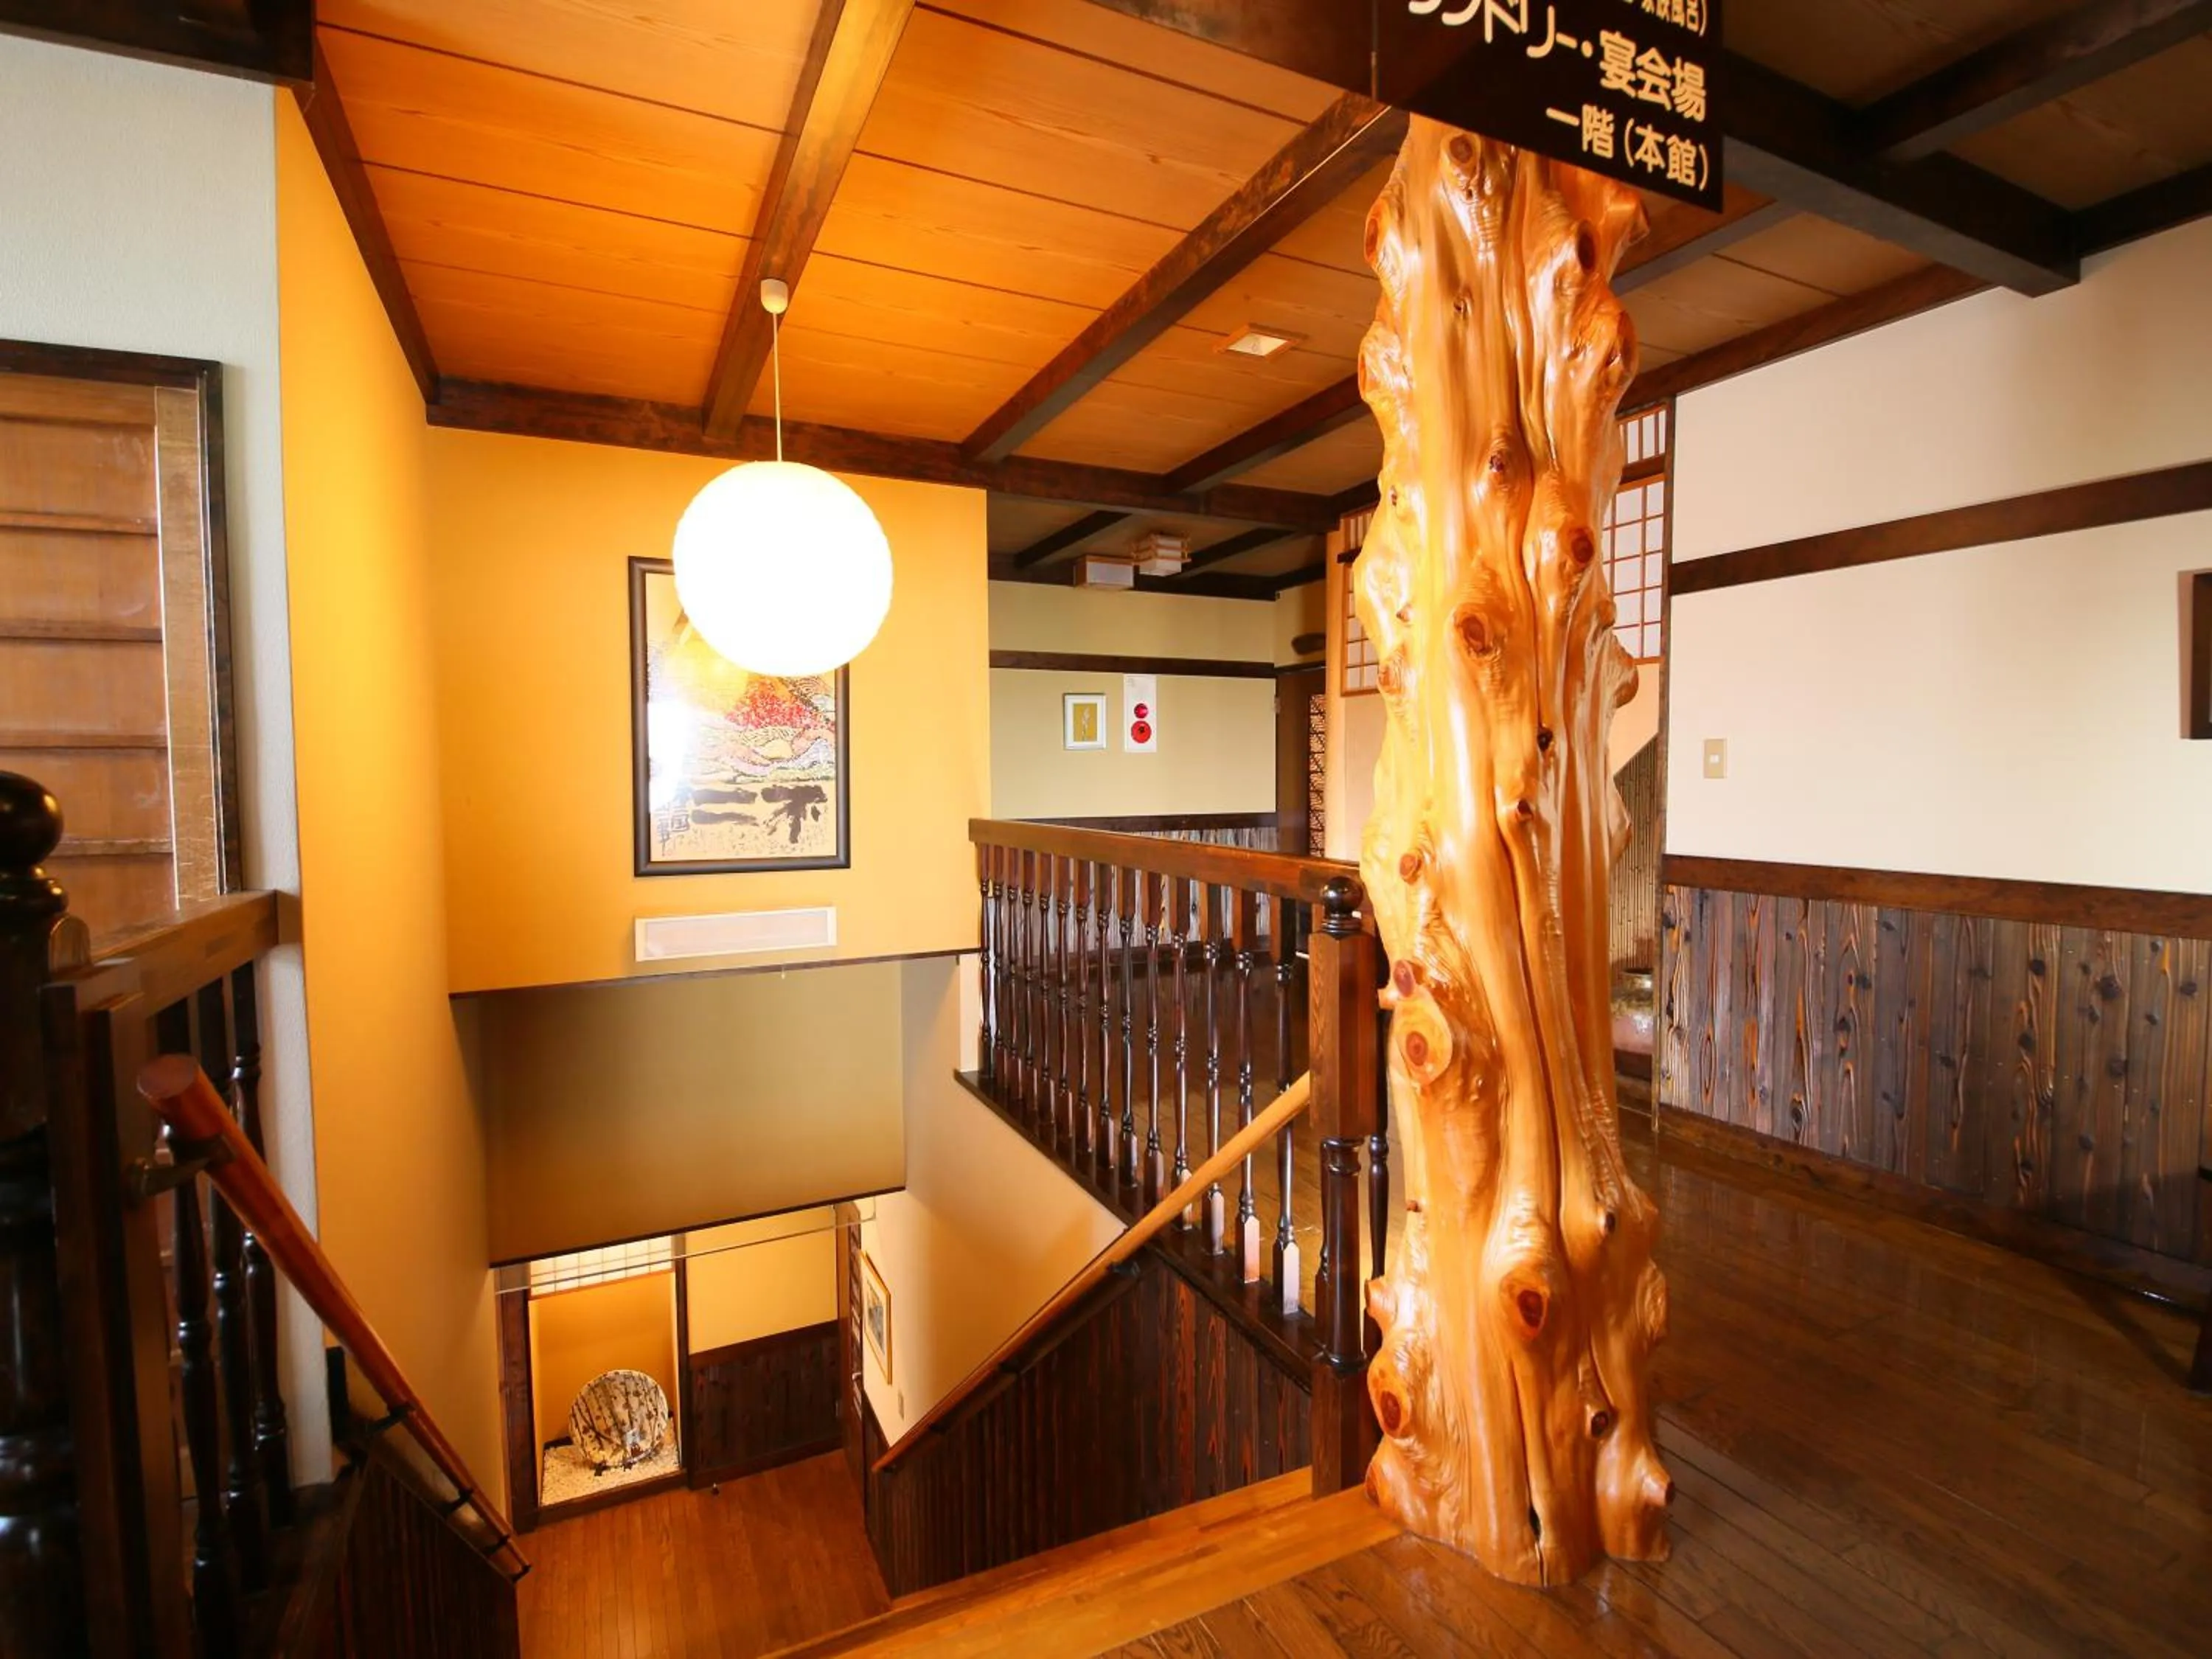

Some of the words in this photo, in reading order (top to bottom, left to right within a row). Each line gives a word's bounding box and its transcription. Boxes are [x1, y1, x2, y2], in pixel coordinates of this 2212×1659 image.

[1408, 0, 1706, 122] ドリー・宴会場
